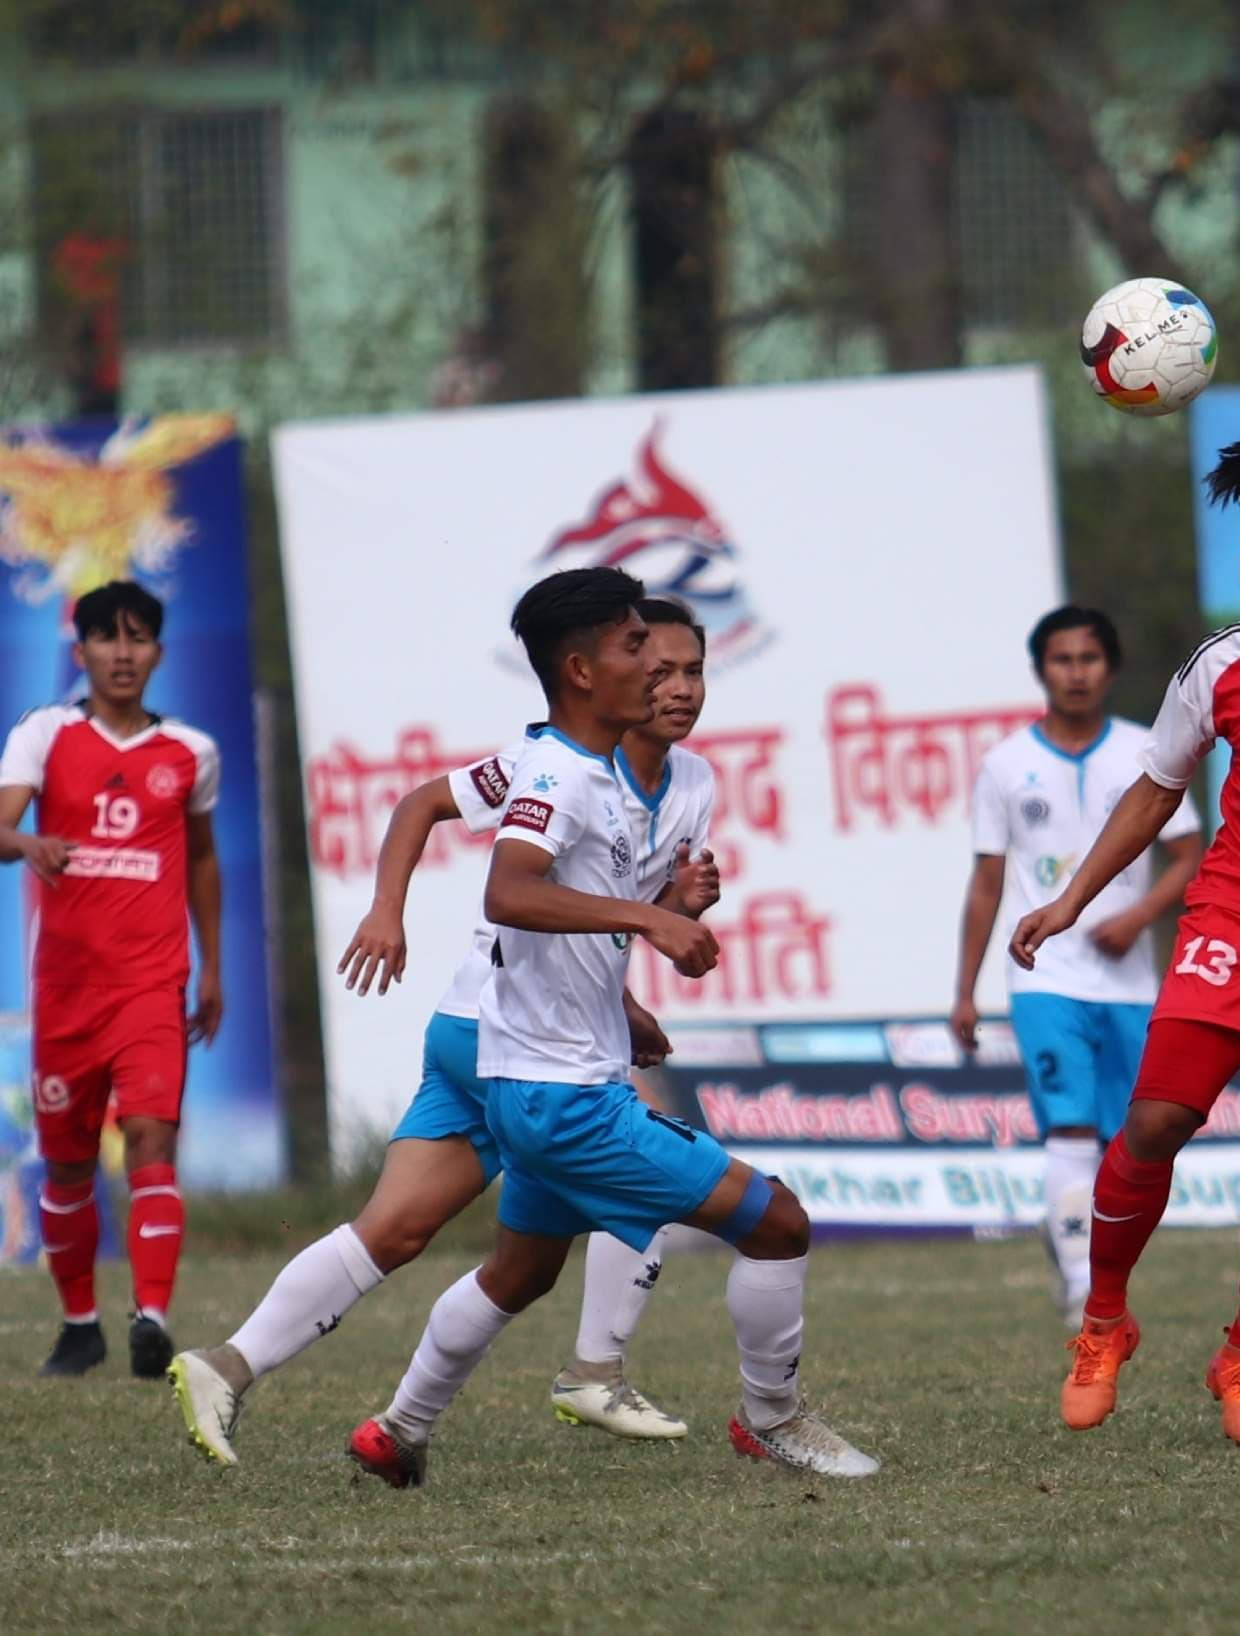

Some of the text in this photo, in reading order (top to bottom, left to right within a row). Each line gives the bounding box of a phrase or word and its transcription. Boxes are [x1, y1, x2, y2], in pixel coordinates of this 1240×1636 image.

[1123, 314, 1180, 356] KELME
[91, 791, 140, 839] 19
[509, 803, 548, 820] QATAR
[1175, 936, 1237, 986] 13
[33, 1072, 70, 1113] 19
[1036, 1051, 1064, 1094] 2
[696, 1081, 902, 1140] National
